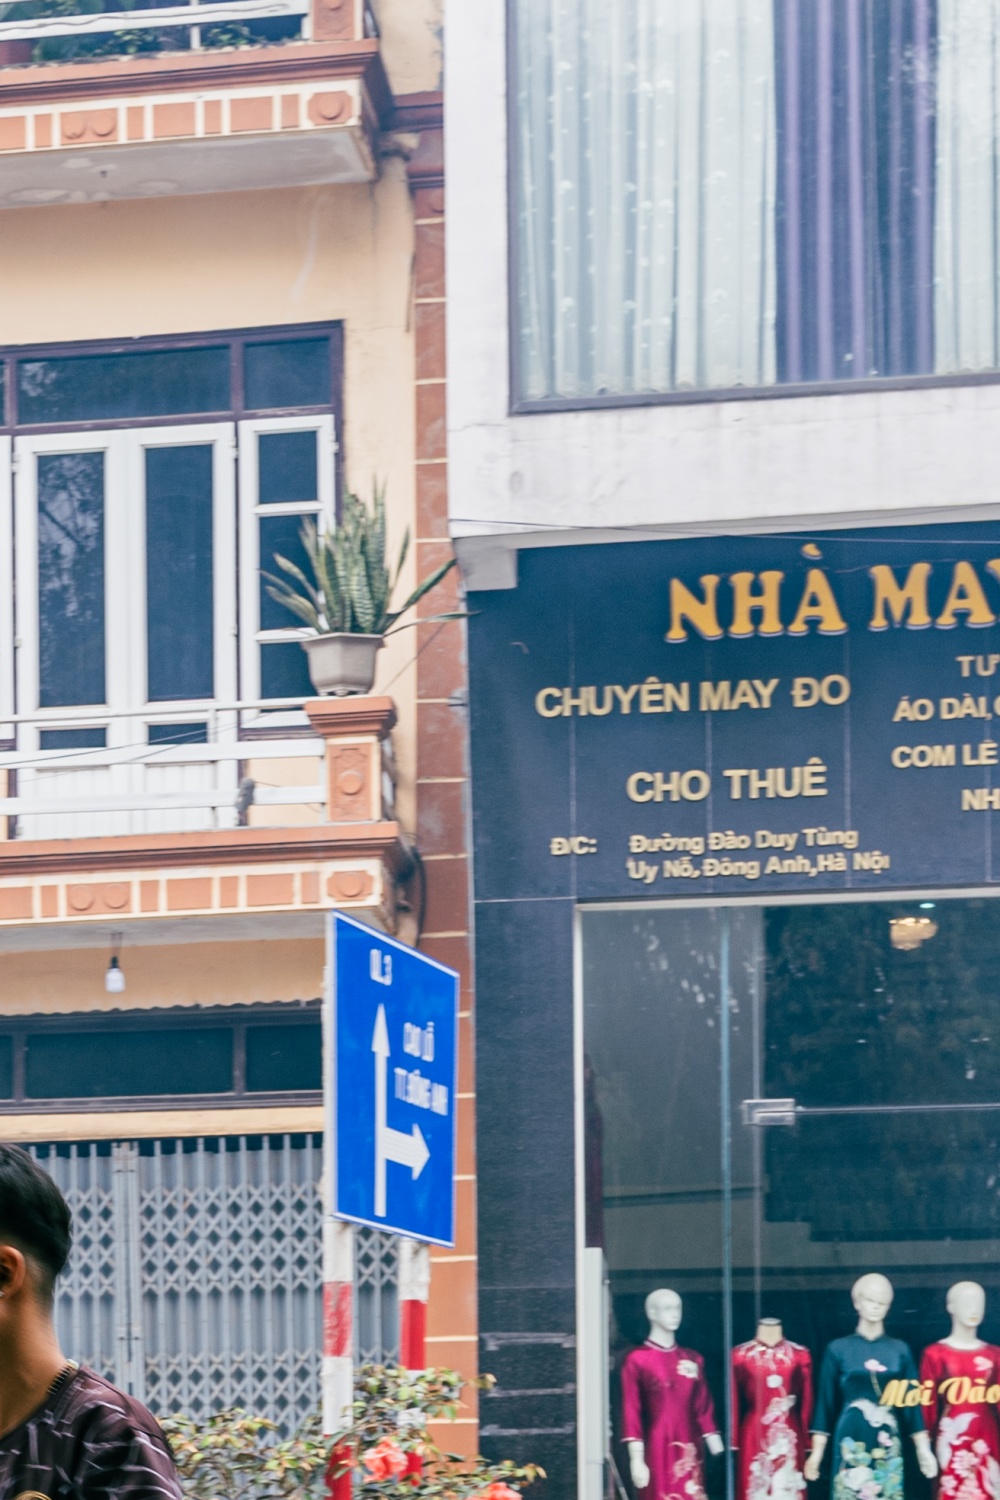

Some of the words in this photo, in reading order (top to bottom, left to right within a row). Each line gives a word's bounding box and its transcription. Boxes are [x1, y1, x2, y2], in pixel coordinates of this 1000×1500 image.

[665, 543, 848, 643] NHÀ
[535, 676, 690, 717] CHUYÊN
[700, 678, 780, 711] MAY
[790, 674, 850, 707] ĐO
[892, 695, 934, 722] ÁO
[891, 744, 956, 769] COM
[962, 740, 998, 766] LÊ
[626, 770, 711, 803] CHO
[723, 757, 828, 800] THUÊ
[629, 833, 705, 855] Đường
[708, 830, 751, 850] Đào
[755, 830, 798, 851] Duy
[627, 859, 658, 884] Uy
[852, 850, 890, 874] Nội
